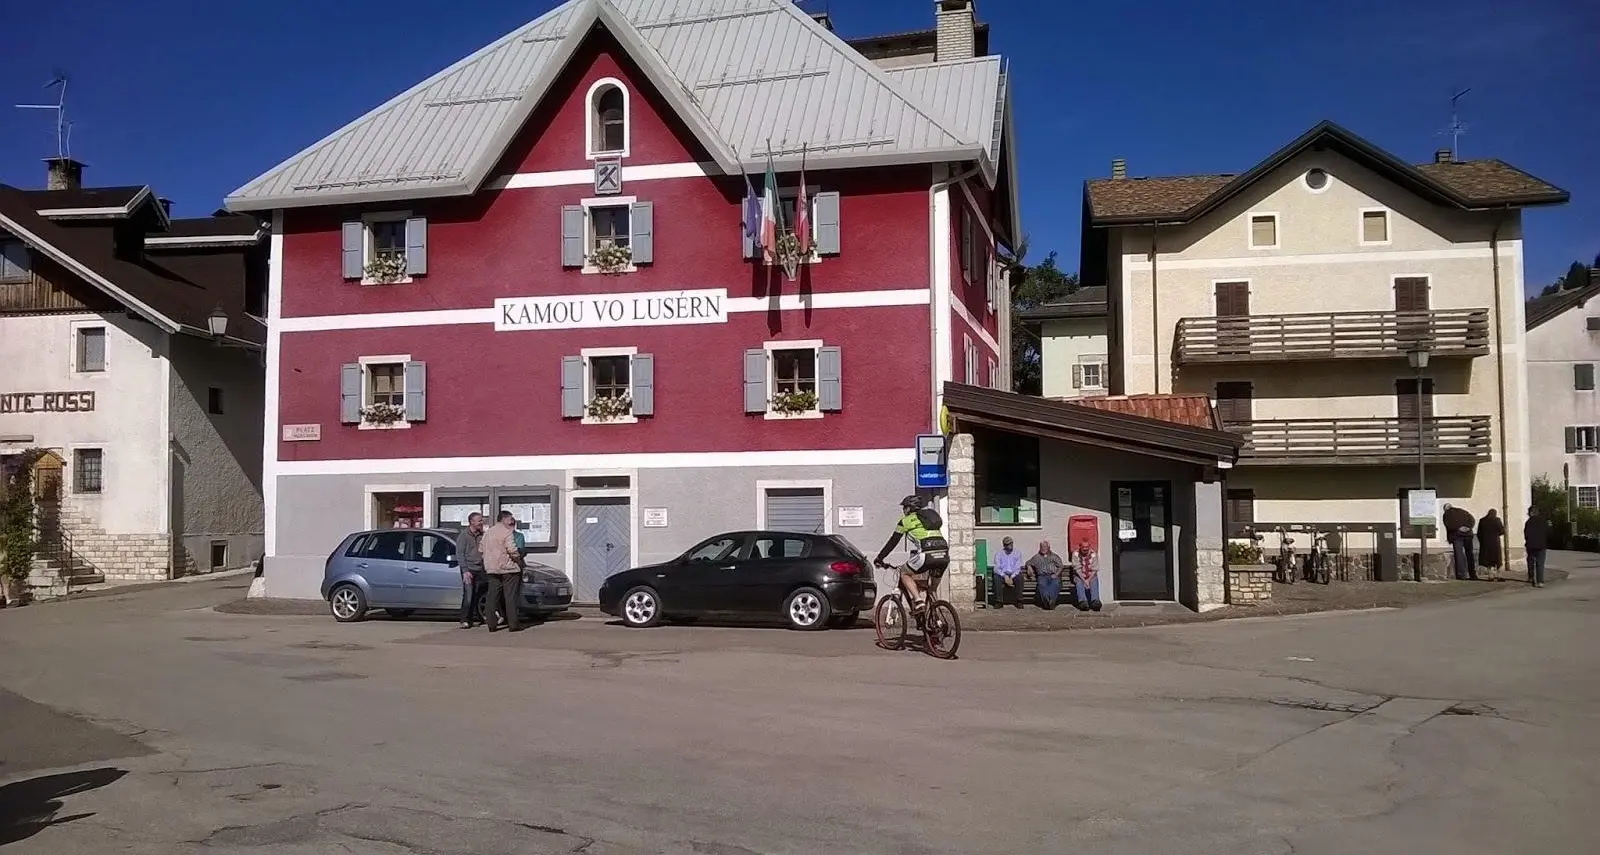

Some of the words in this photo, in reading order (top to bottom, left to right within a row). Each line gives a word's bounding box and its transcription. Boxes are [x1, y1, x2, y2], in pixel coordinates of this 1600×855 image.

[502, 301, 584, 325] KAMOU
[592, 300, 624, 321] VO
[632, 292, 721, 320] LUSÉRN
[44, 391, 95, 412] ROSSI
